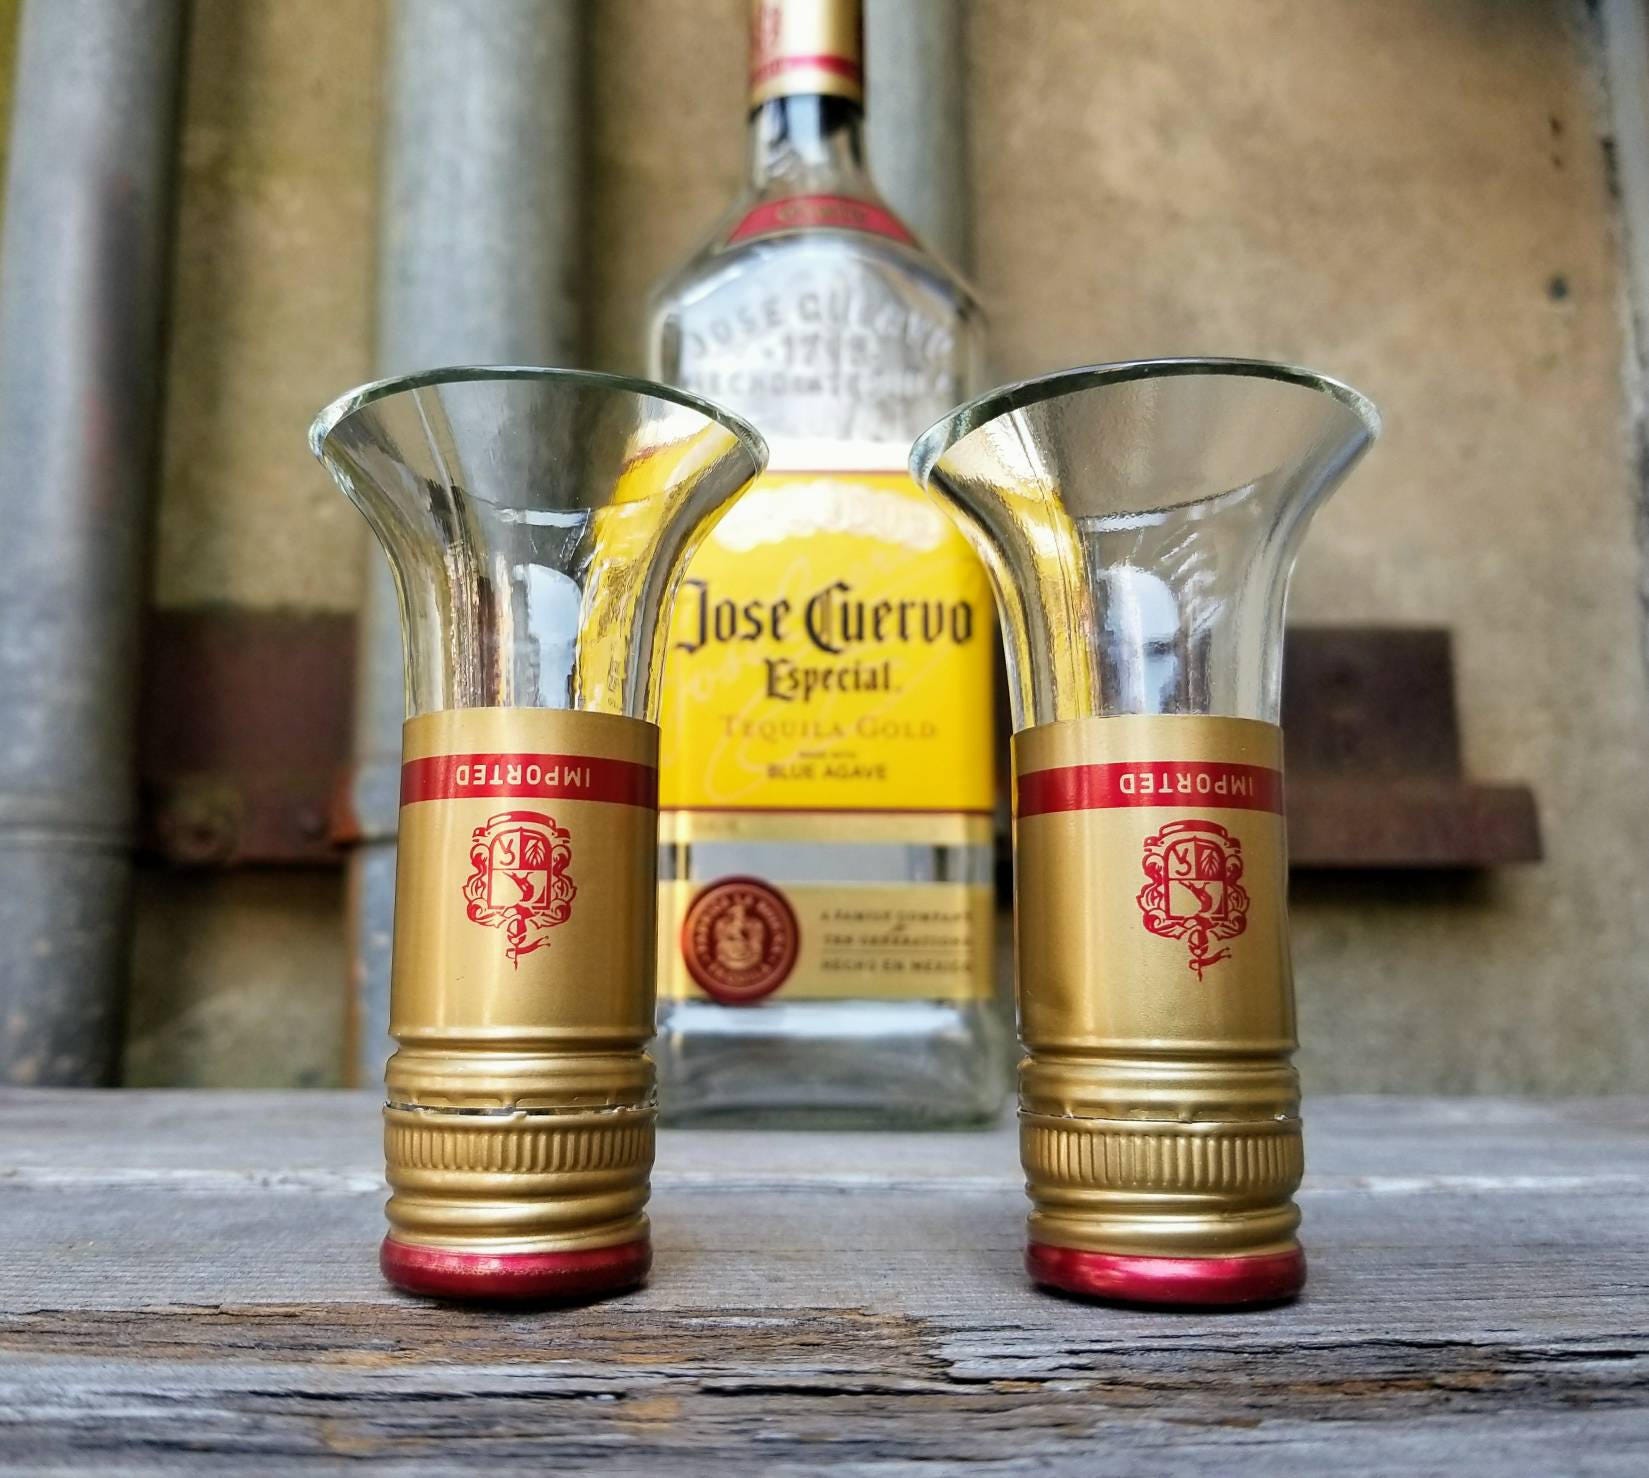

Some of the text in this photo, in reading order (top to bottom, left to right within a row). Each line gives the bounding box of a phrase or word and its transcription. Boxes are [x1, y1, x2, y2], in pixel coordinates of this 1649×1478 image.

[675, 578, 973, 655] Jose Cuervo
[765, 657, 890, 702] Especial
[455, 763, 591, 788] IMPORTED
[767, 763, 887, 780] BLUE AGAVE
[1119, 772, 1253, 795] IMPORTED
